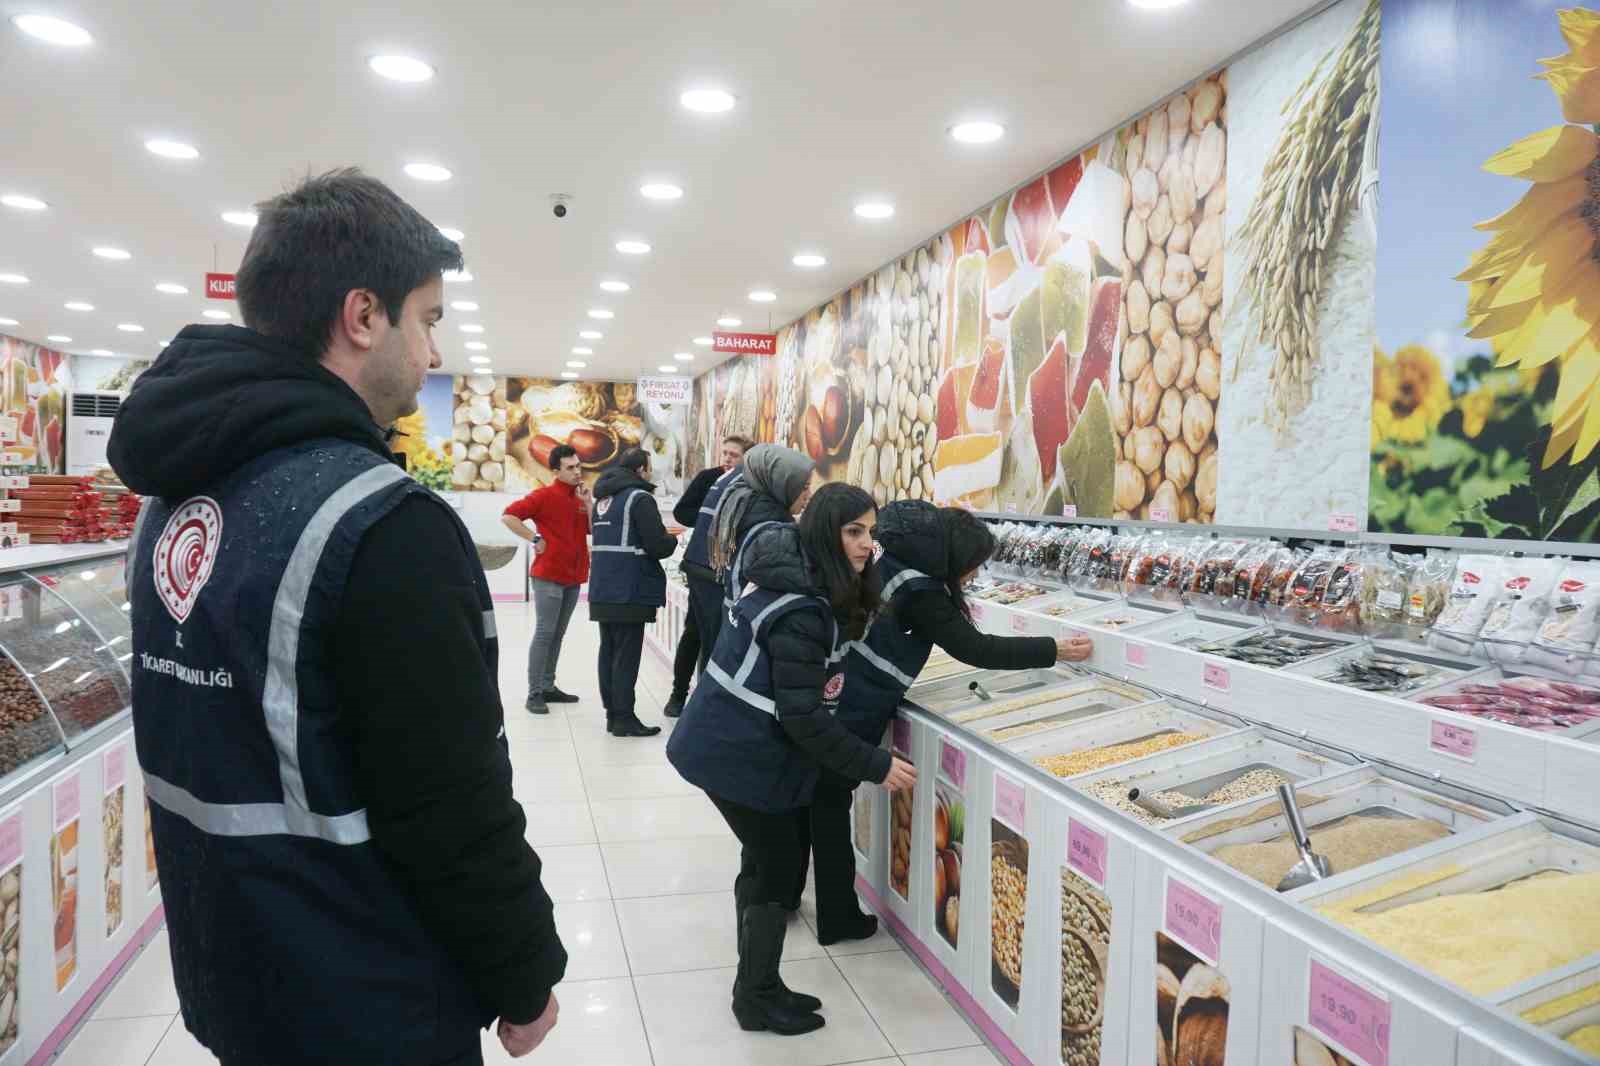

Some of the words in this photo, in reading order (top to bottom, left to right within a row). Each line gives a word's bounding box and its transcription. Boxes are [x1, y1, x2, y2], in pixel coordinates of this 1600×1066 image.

[209, 279, 236, 293] KUR
[716, 336, 773, 351] BAHARAT
[646, 390, 684, 400] REYONU
[140, 652, 176, 677] TİCARET
